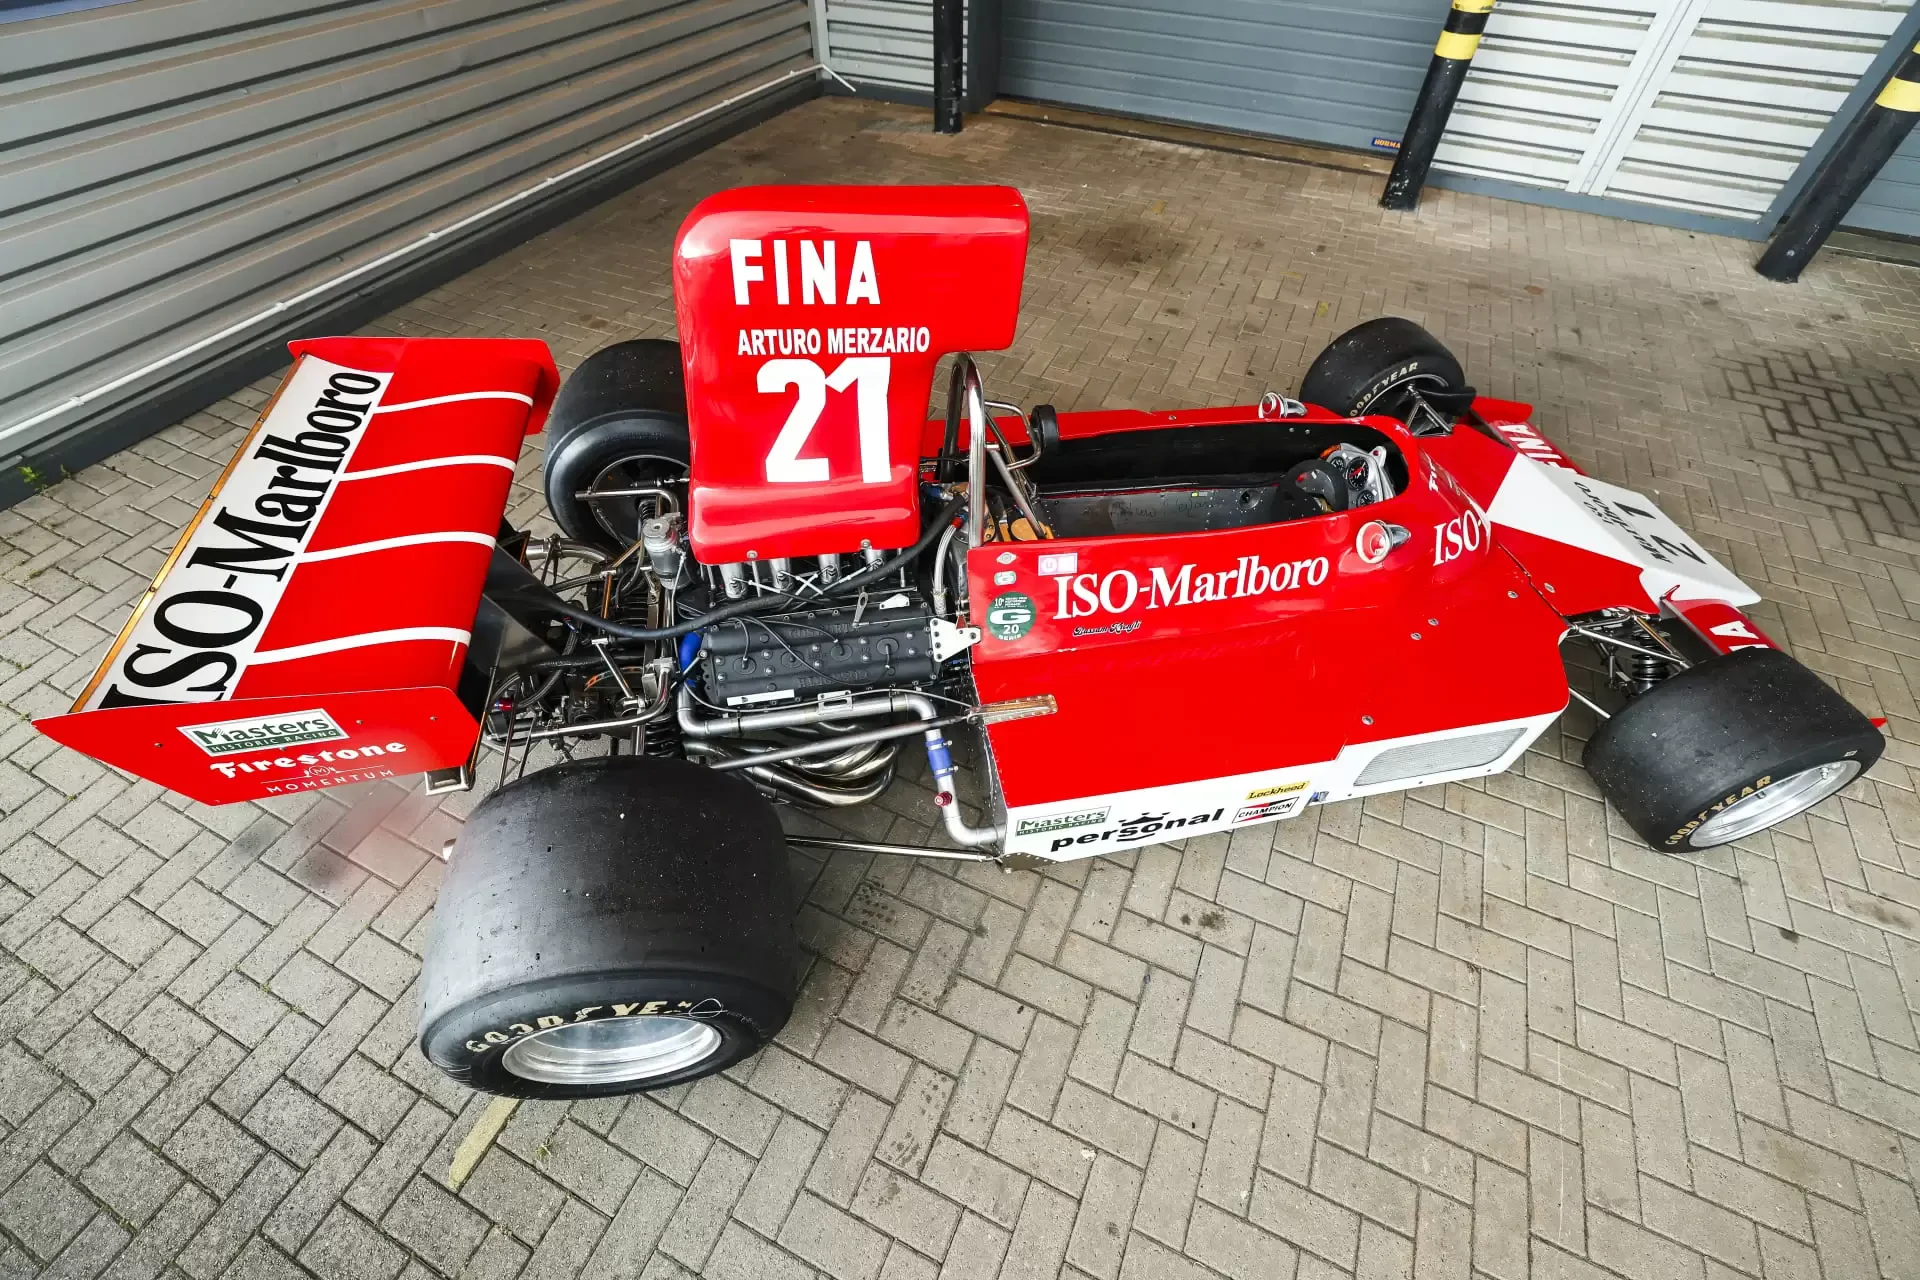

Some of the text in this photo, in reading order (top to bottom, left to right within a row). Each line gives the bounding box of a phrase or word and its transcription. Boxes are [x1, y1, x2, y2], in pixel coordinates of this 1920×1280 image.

[729, 238, 881, 305] FINA
[738, 326, 930, 356] ARTURO MERZARIO
[1349, 362, 1418, 417] OODYEAR
[756, 356, 892, 484] 21
[1052, 555, 1329, 621] ISO-Marlboro
[989, 608, 1032, 625] G
[1003, 624, 1020, 635] 20
[193, 718, 331, 747] Masters
[211, 730, 337, 753] HISTORIC RACING
[210, 742, 408, 779] Firestone
[266, 769, 394, 794] MOMENTUM
[1247, 782, 1306, 799] Lockheed
[1020, 811, 1106, 830] Masters
[1238, 802, 1293, 818] CHAMPION
[1665, 775, 1771, 845] GOODYEAR
[1050, 808, 1225, 852] personal
